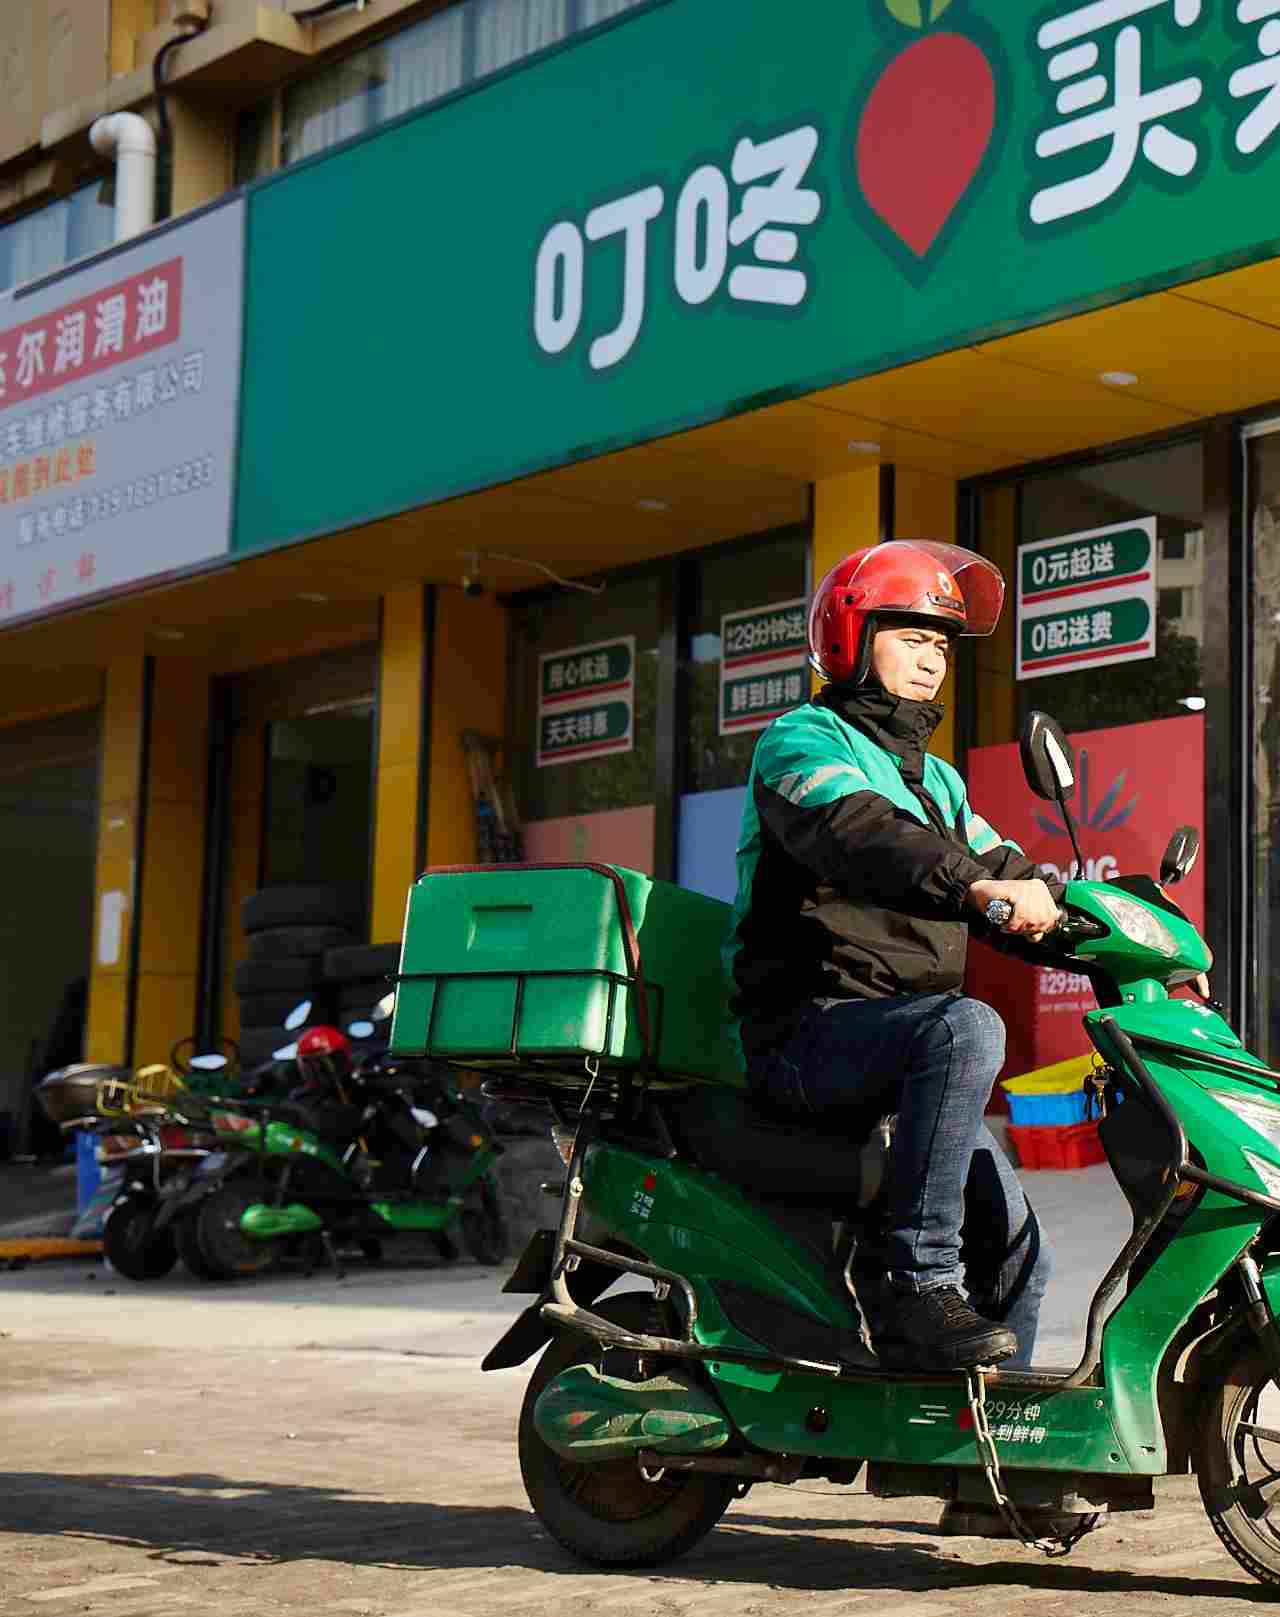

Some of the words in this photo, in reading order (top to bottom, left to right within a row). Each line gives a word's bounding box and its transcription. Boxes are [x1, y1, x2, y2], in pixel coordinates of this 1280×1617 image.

[534, 125, 820, 370] 叮咚
[1032, 541, 1115, 586] 0元起送
[735, 610, 808, 650] 29分钟送
[1031, 610, 1113, 653] 0配送费
[731, 675, 801, 711] 鲜到鲜得
[984, 1400, 1041, 1421] 29分钟
[988, 1423, 1047, 1444] 到鲜得
